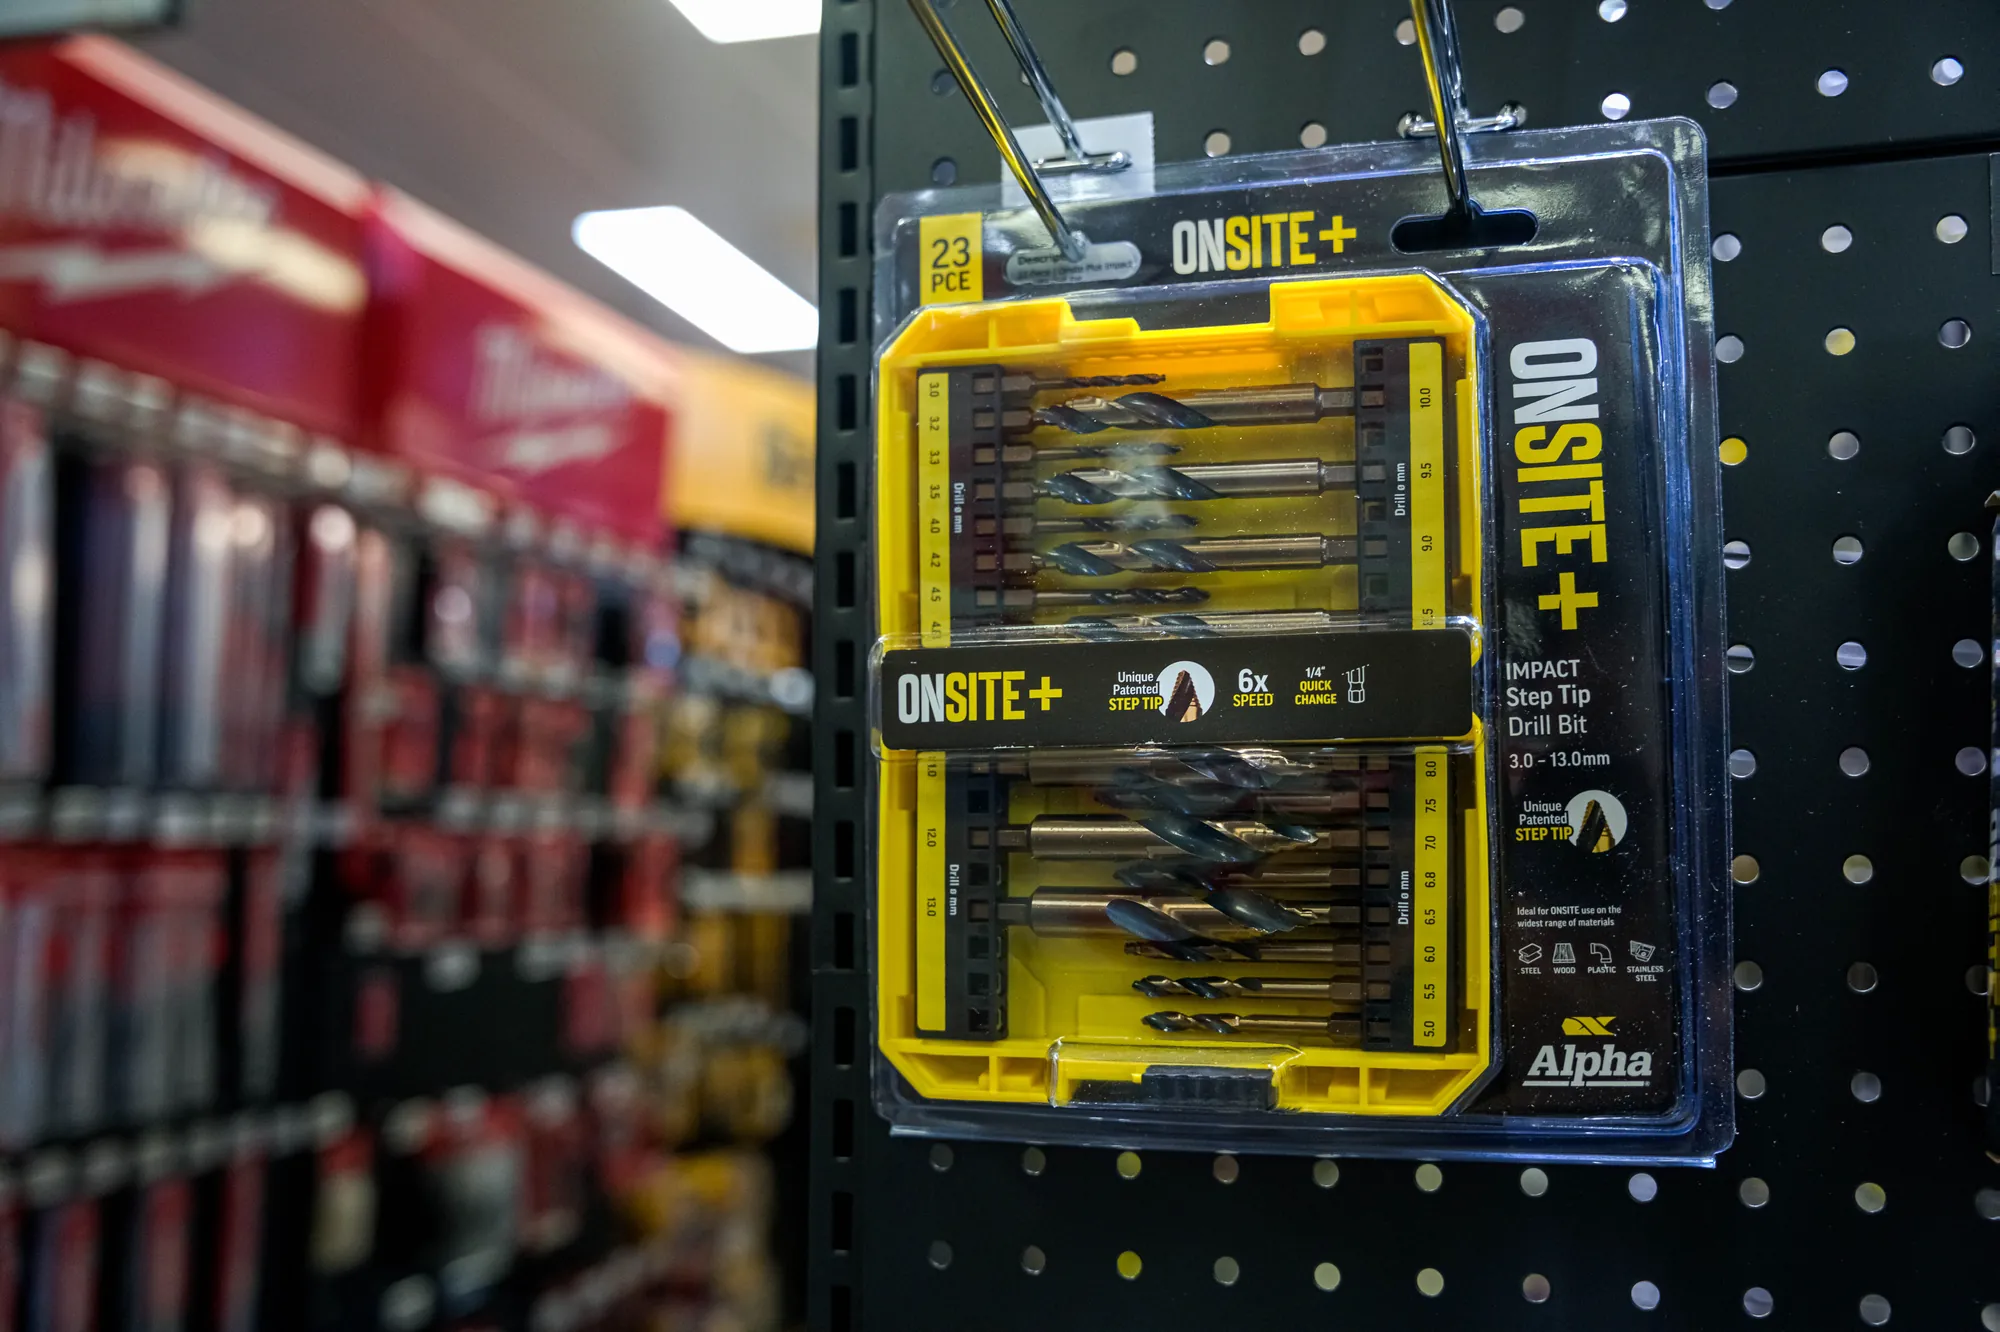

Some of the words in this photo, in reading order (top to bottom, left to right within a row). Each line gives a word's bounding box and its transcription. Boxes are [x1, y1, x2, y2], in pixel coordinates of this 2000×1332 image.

[931, 237, 970, 269] 23
[931, 270, 971, 293] PCE
[929, 382, 939, 398] 3.0
[1419, 387, 1431, 409] 10.0
[929, 416, 940, 432] 3.2
[929, 450, 940, 465] 3.3
[1397, 462, 1406, 482] mm
[1420, 462, 1432, 479] 9.5
[929, 484, 940, 500] 3.5
[954, 482, 964, 505] Drill
[1394, 493, 1405, 516] Drill
[930, 518, 941, 534] 4.0
[954, 515, 962, 534] mm
[1421, 535, 1432, 552] 9.0
[930, 552, 941, 568] 4.2
[931, 586, 942, 602] 4.5
[1117, 671, 1154, 684] Unique
[1505, 659, 1580, 681] IMPACT
[1238, 668, 1269, 693] 6x
[1299, 680, 1332, 693] QUICK
[1112, 683, 1159, 696] Patented
[1506, 686, 1553, 710] Step
[1557, 684, 1591, 708] Tip
[1108, 697, 1141, 711] STEP
[1142, 696, 1164, 710] TIP
[1233, 693, 1274, 707] SPEED
[1294, 693, 1337, 706] CHANGE
[1508, 714, 1551, 737] Drill
[1558, 713, 1588, 735] Bit
[1425, 760, 1436, 778] 8.0
[1509, 752, 1533, 769] 3.0
[1425, 798, 1436, 814] 7.5
[1523, 801, 1562, 814] Unique
[1519, 812, 1568, 826] Patented
[926, 827, 937, 848] 12.0
[1515, 827, 1548, 842] STEP
[1551, 826, 1574, 841] TIP
[1425, 835, 1436, 851] 7.0
[949, 864, 960, 886] Drill
[1400, 870, 1409, 890] mm
[1424, 871, 1436, 889] 6.8
[926, 897, 937, 917] 13.0
[950, 897, 958, 916] mm
[1397, 901, 1409, 925] Drill
[1517, 906, 1536, 916] Ideal
[1537, 906, 1549, 915] for
[1550, 906, 1580, 915] ONSITE
[1581, 907, 1595, 915] use
[1608, 905, 1622, 914] the
[1424, 908, 1436, 926] 6.5
[1517, 918, 1544, 928] widest
[1544, 919, 1567, 929] range
[1568, 918, 1577, 927] of
[1578, 917, 1615, 927] materials
[1424, 946, 1435, 963] 6.0
[1520, 967, 1542, 975] STEEL
[1553, 966, 1576, 974] WOOD
[1587, 966, 1617, 974] PLASTIC
[1626, 965, 1664, 973] STAINLESS
[1635, 974, 1657, 982] STEEL
[1424, 983, 1435, 1000] 5.5
[1423, 1020, 1435, 1038] 5.0
[1527, 1044, 1653, 1087] Alpha
